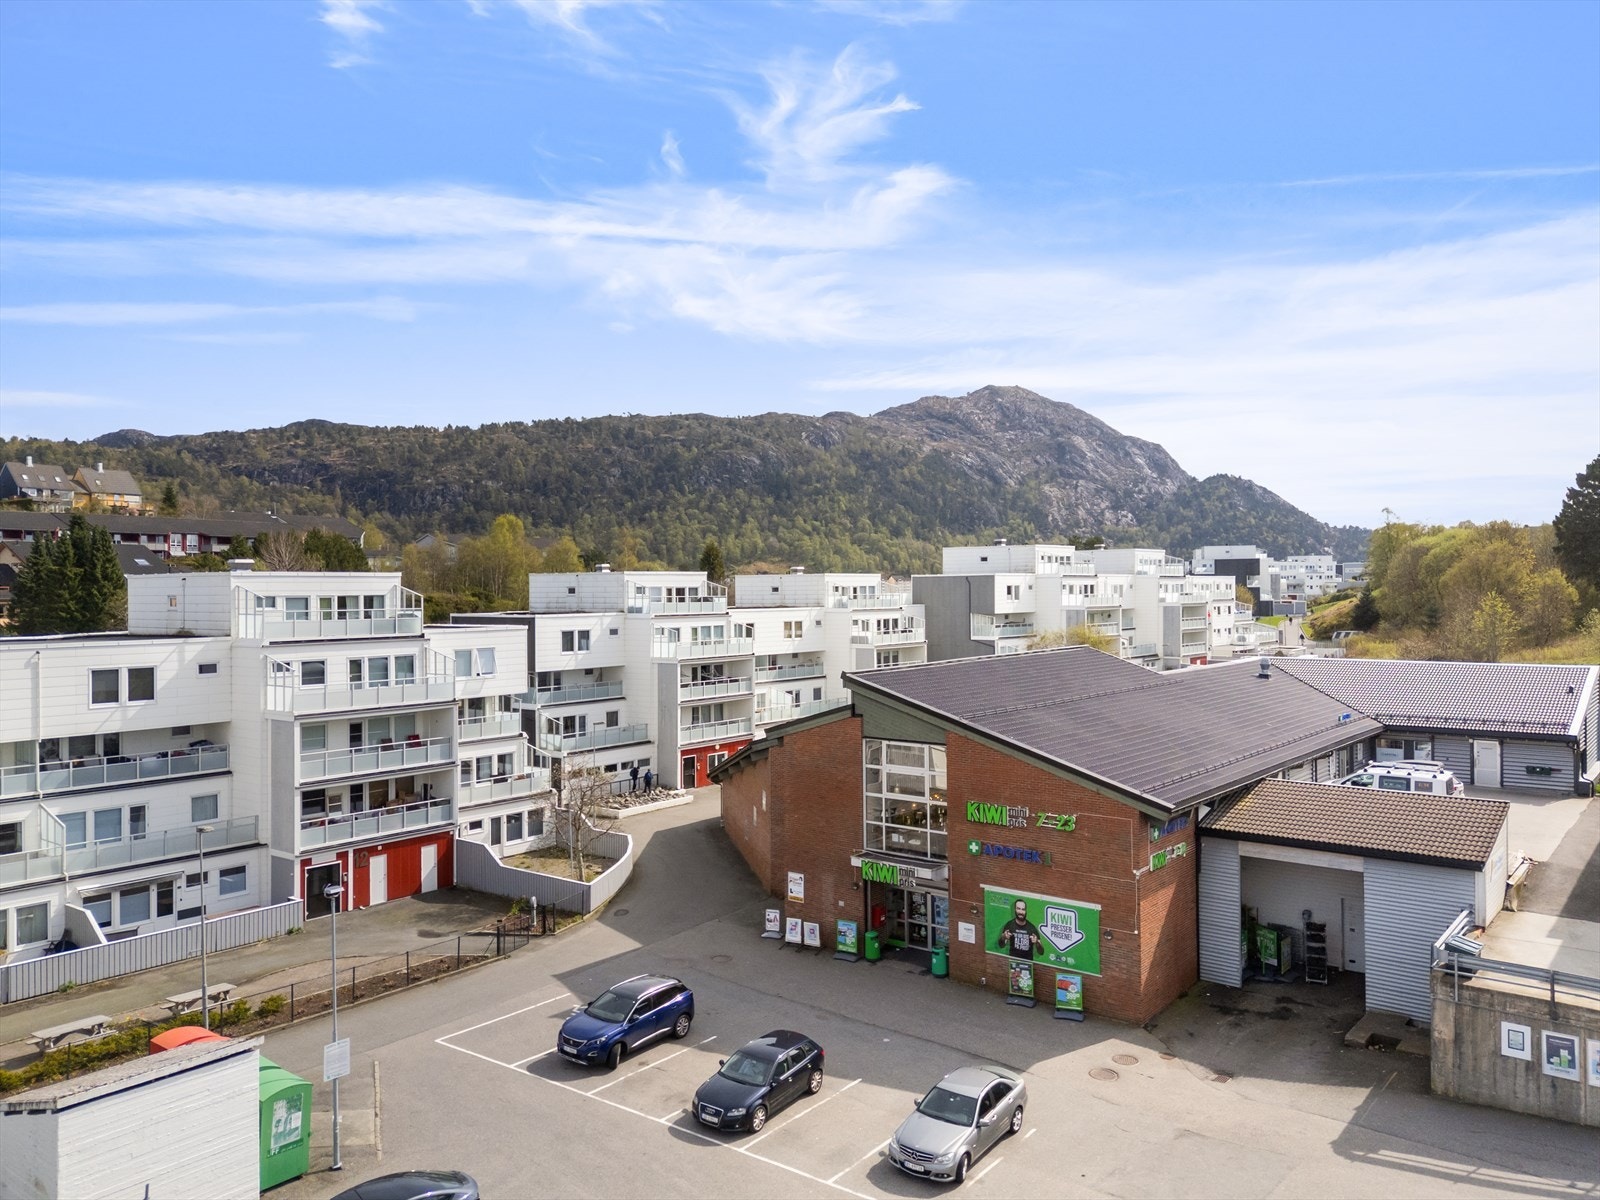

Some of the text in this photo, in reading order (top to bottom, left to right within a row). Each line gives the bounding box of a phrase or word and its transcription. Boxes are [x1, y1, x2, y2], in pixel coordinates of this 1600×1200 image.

[967, 801, 1007, 826] KIWI
[1008, 807, 1028, 818] mini
[1008, 818, 1026, 828] pris
[354, 851, 369, 868] 12
[983, 843, 1051, 865] APOTEK 1
[861, 860, 898, 886] KIWI
[900, 867, 916, 878] mini
[900, 879, 916, 888] pris
[1050, 912, 1072, 926] KIWI
[1050, 923, 1073, 934] PRESSER
[1050, 931, 1073, 941] PRISENE!
